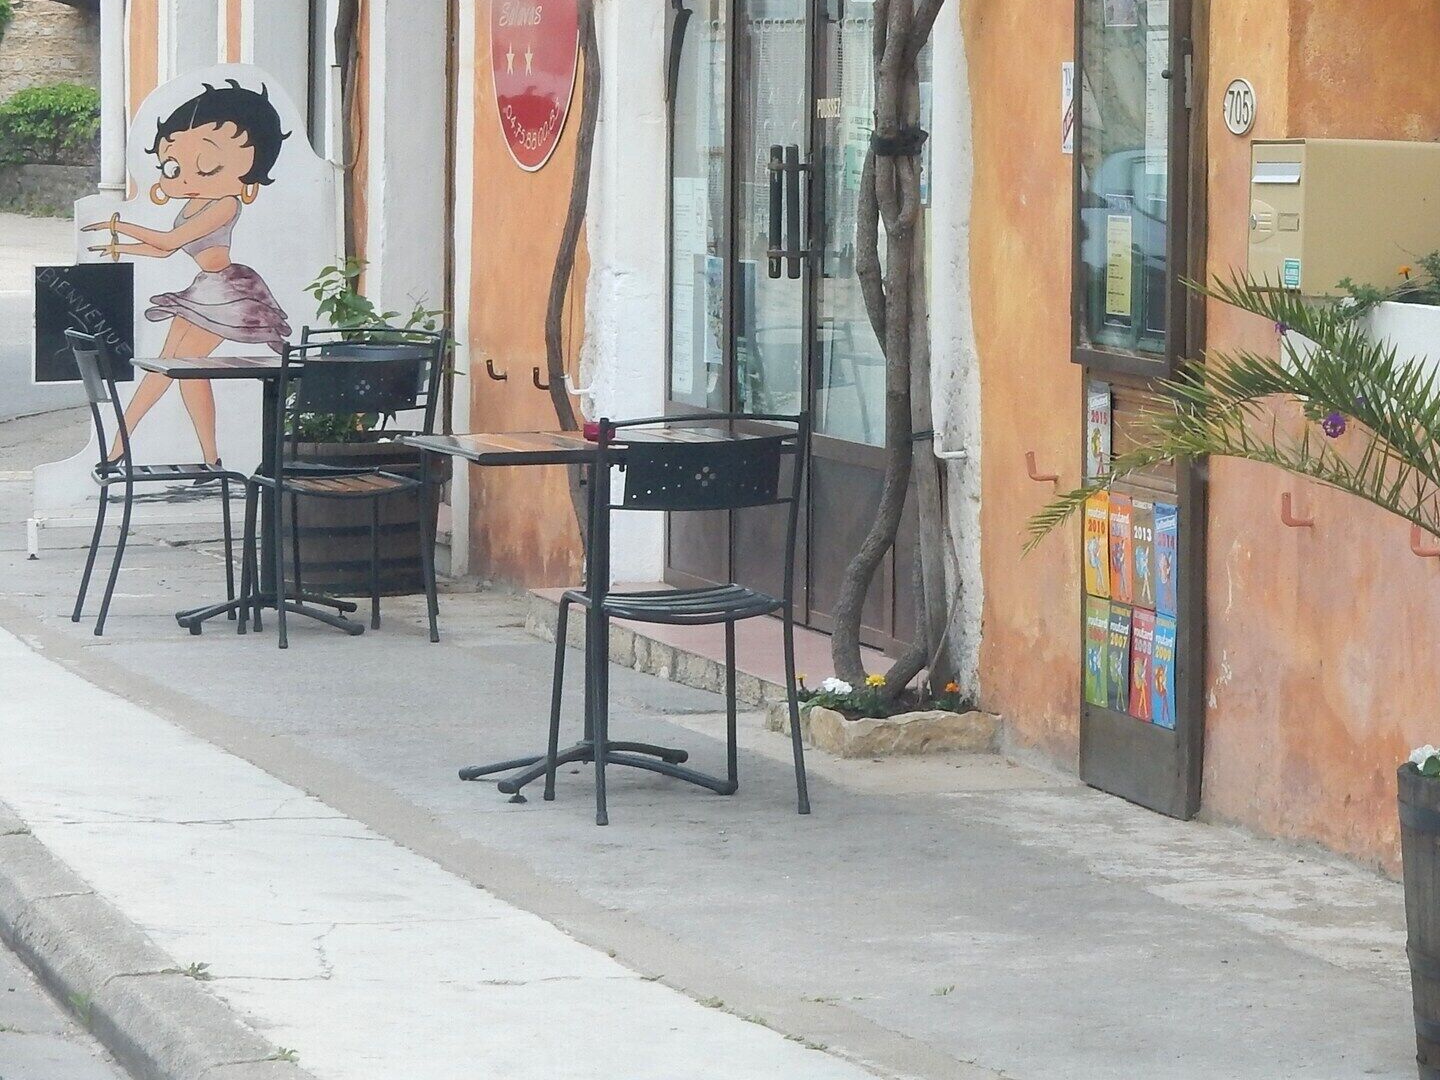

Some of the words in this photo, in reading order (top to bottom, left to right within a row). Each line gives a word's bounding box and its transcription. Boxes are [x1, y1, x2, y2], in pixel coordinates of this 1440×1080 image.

[1228, 90, 1249, 125] 705
[37, 268, 132, 354] BIENVENUE
[1088, 519, 1105, 534] 2010
[1133, 525, 1152, 542] 2013
[1110, 632, 1127, 648] 2007
